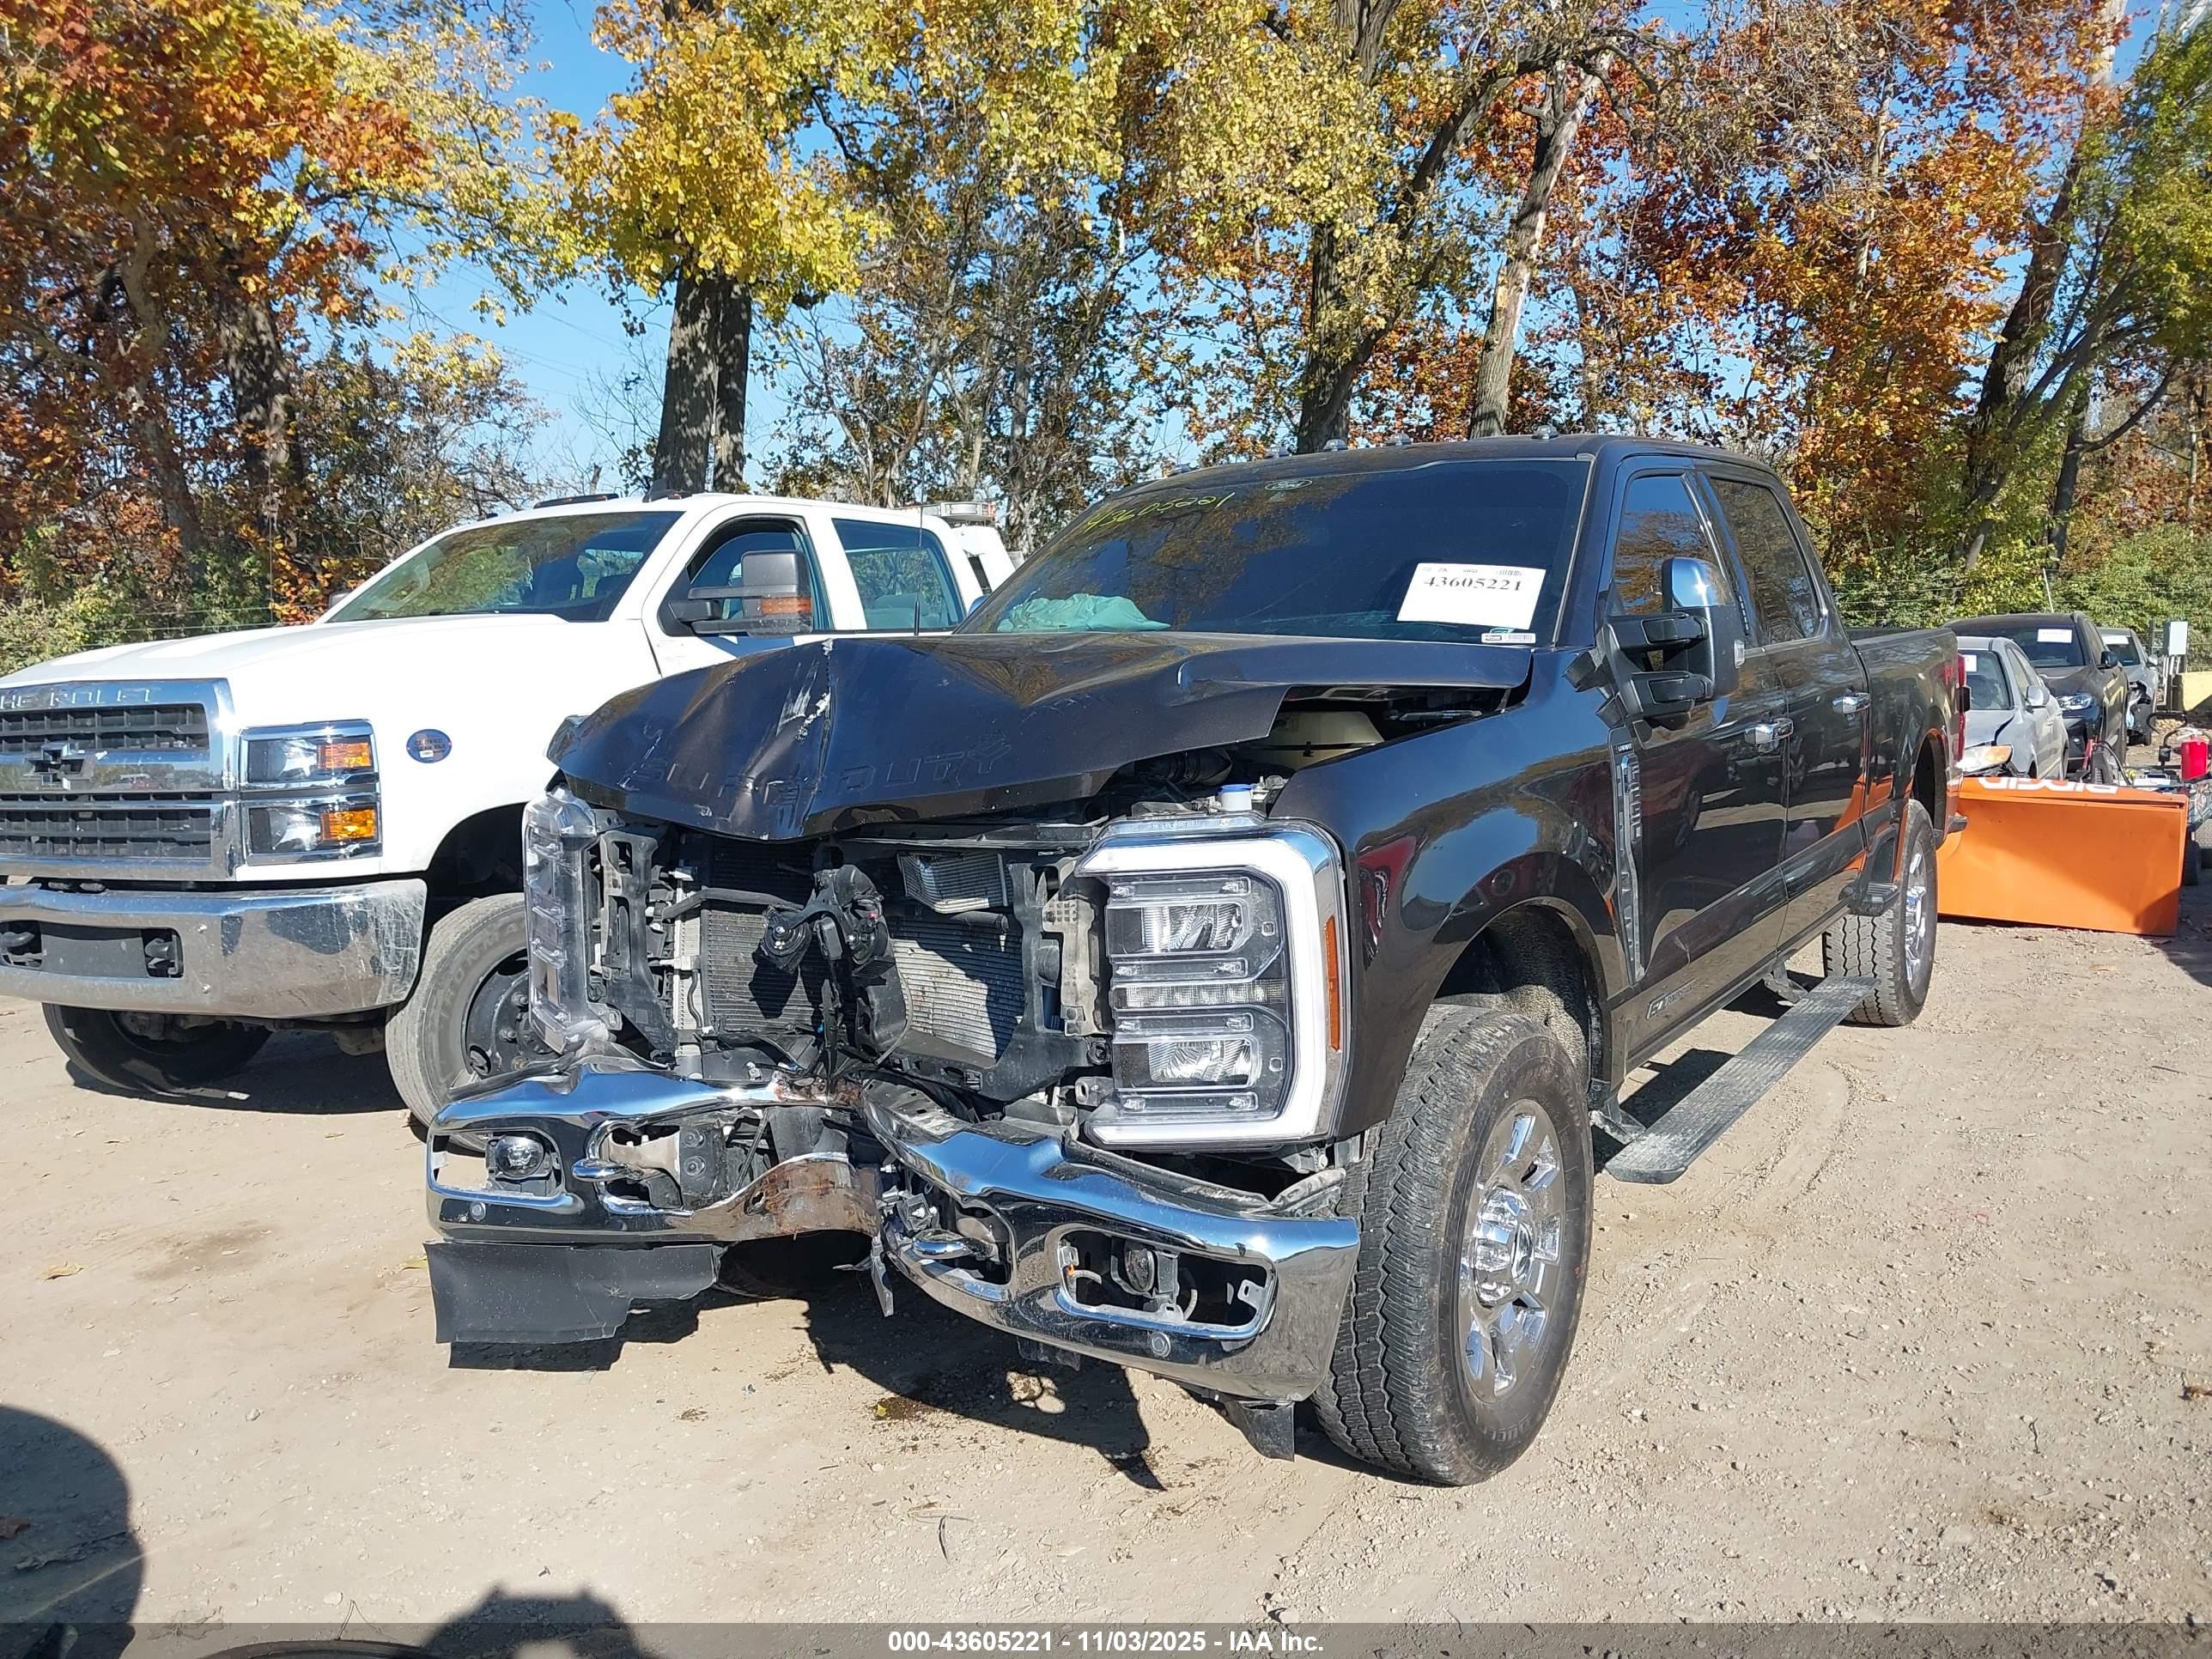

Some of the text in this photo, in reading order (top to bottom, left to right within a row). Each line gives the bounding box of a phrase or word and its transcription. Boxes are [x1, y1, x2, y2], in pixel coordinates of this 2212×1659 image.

[1082, 492, 1236, 534] 43605221
[1424, 575, 1522, 592] 43605221
[837, 738, 1012, 793] DUTY
